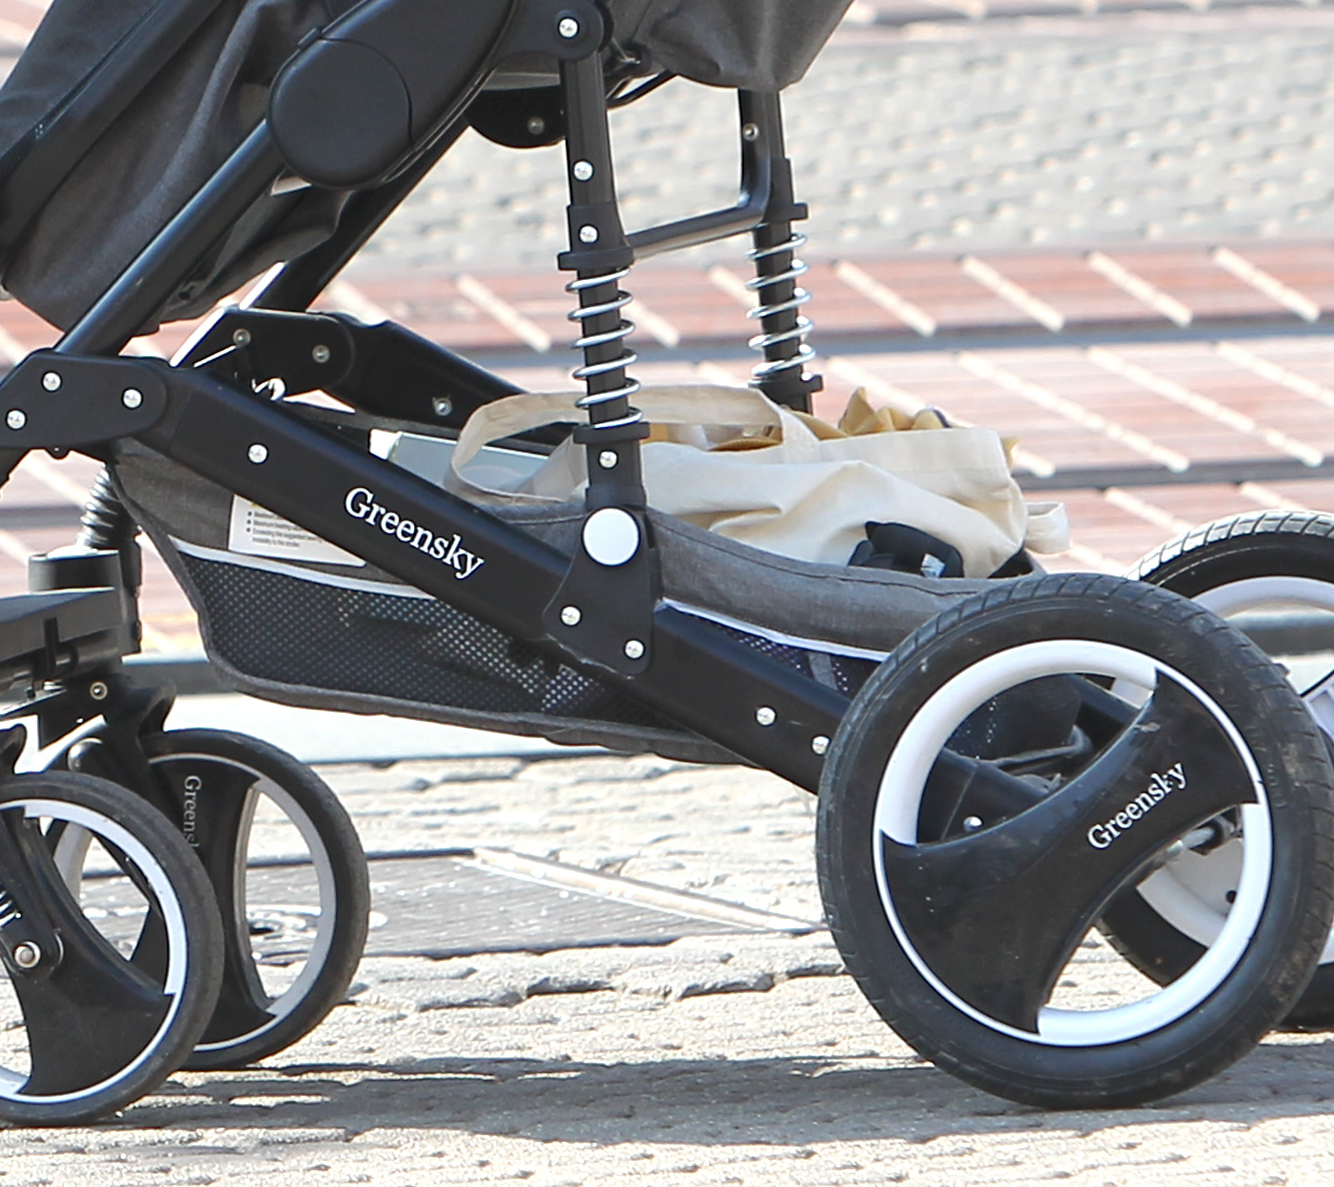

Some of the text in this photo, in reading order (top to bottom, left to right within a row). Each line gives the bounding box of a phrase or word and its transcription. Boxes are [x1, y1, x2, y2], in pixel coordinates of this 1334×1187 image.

[345, 487, 485, 579] Greensky
[183, 775, 202, 848] Greens
[1087, 762, 1187, 849] Greensky
